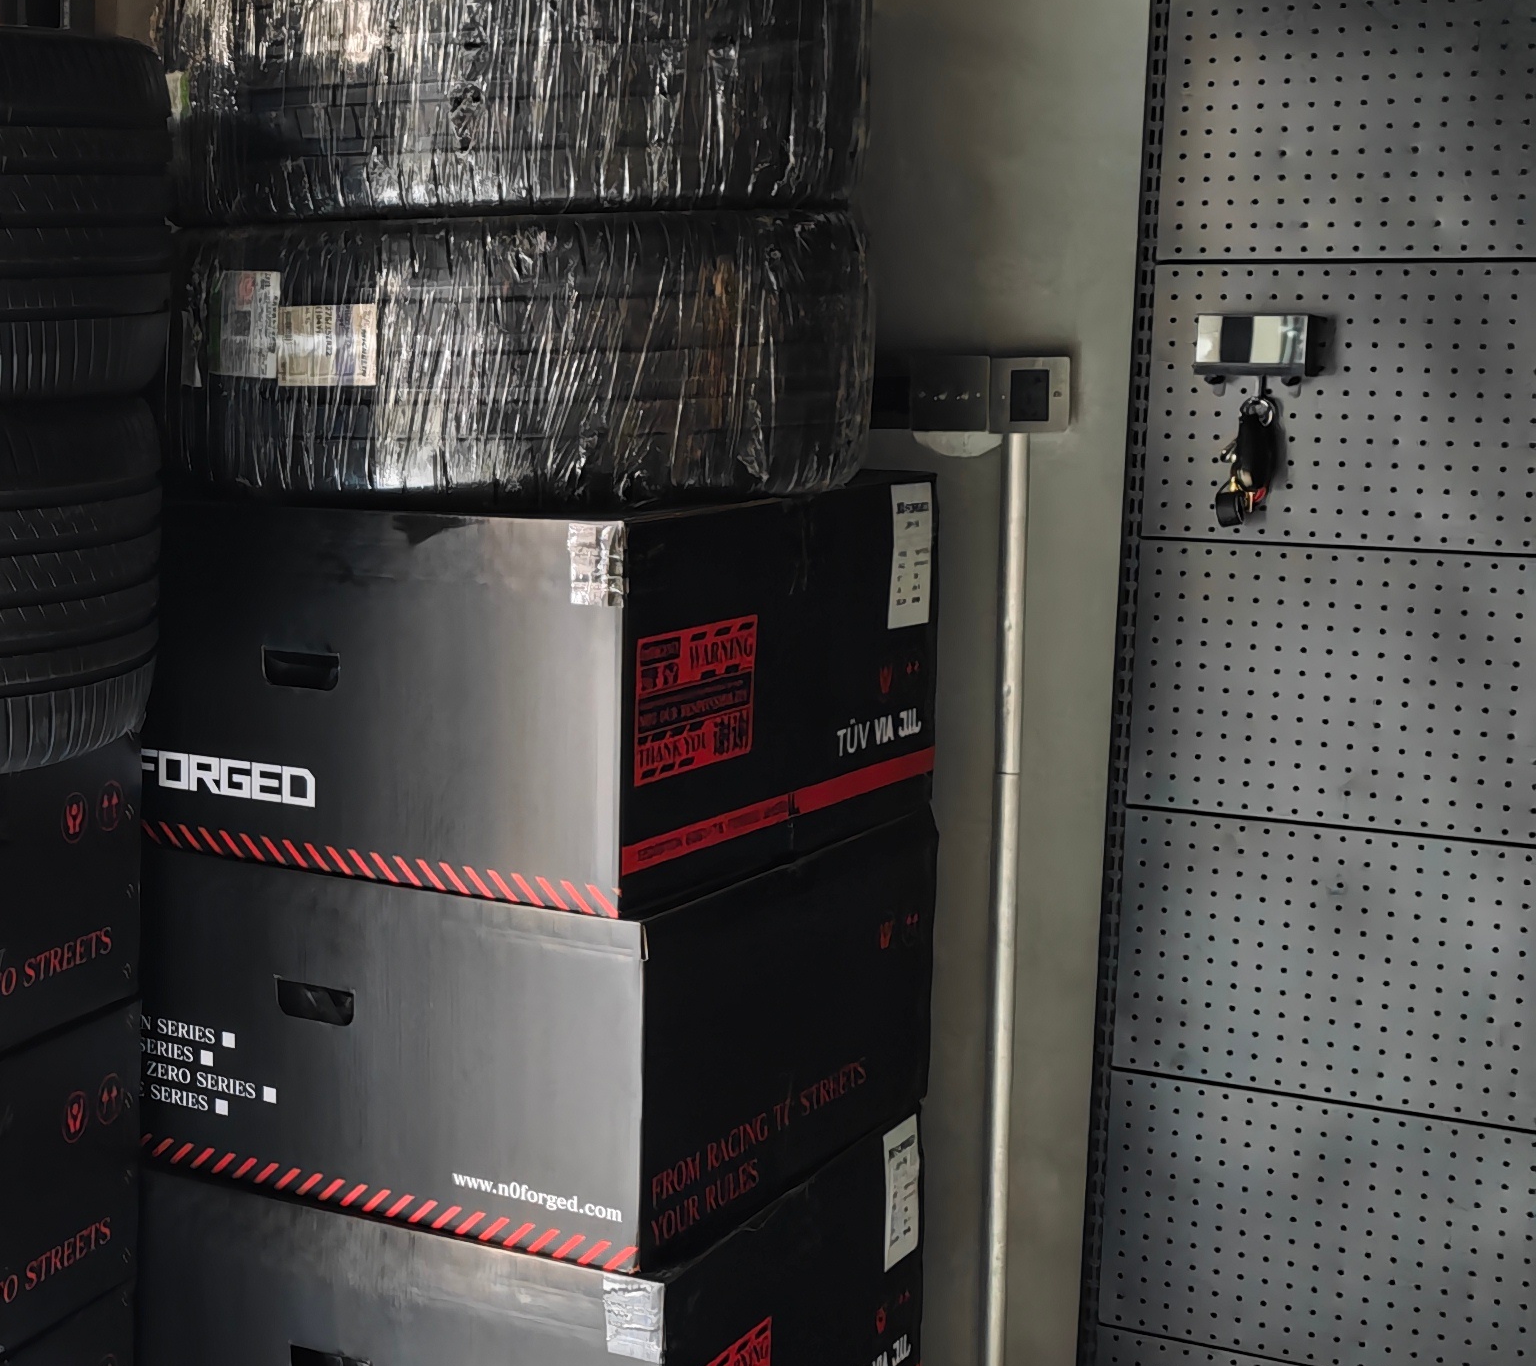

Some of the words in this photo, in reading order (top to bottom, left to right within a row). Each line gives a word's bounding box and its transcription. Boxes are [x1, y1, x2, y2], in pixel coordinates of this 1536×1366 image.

[689, 634, 754, 671] WARNING
[639, 736, 682, 768] THANK
[837, 717, 870, 757] TÜV
[23, 926, 112, 989] STREETS
[157, 1018, 215, 1045] SERIES
[146, 1061, 191, 1084] ZERO
[196, 1072, 256, 1099] SERIES
[150, 1084, 209, 1111] SERIES
[651, 1151, 701, 1209] FROM
[706, 1111, 768, 1171] RACING
[799, 1057, 868, 1117] STREETS
[453, 1172, 623, 1223] www.n0forged.com
[650, 1197, 701, 1246] YOUR
[705, 1158, 760, 1213] RULES
[24, 1217, 112, 1291] STREETS
